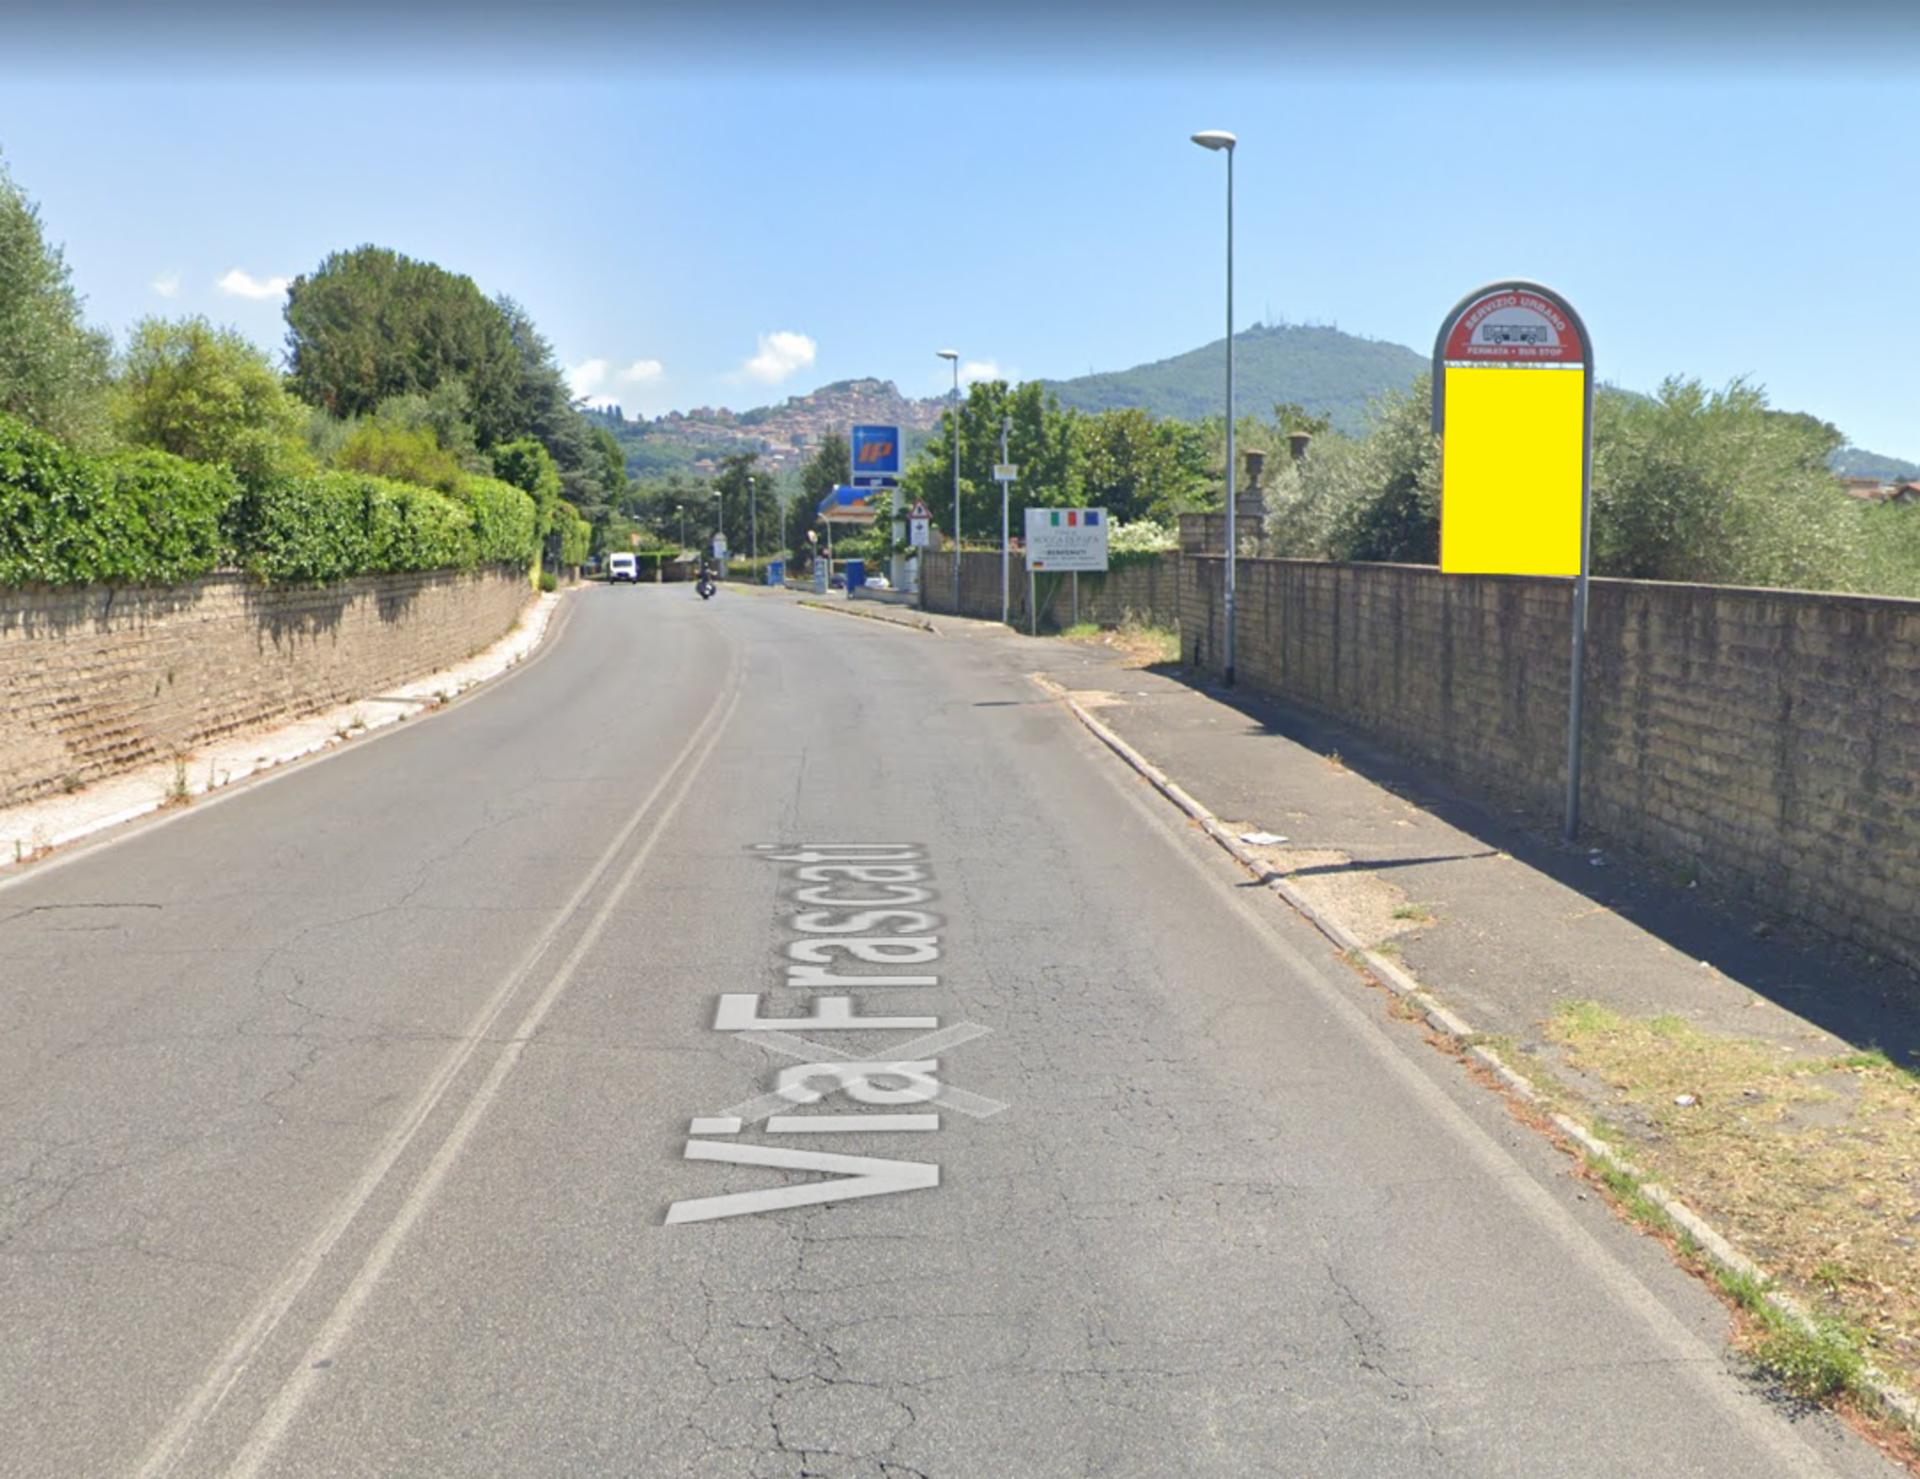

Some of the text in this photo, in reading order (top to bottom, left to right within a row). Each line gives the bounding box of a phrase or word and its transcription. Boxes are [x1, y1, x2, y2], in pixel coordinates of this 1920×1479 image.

[1464, 296, 1565, 331] SERVIZIO URBANO
[1467, 347, 1563, 356] FERMATA BUS STOP
